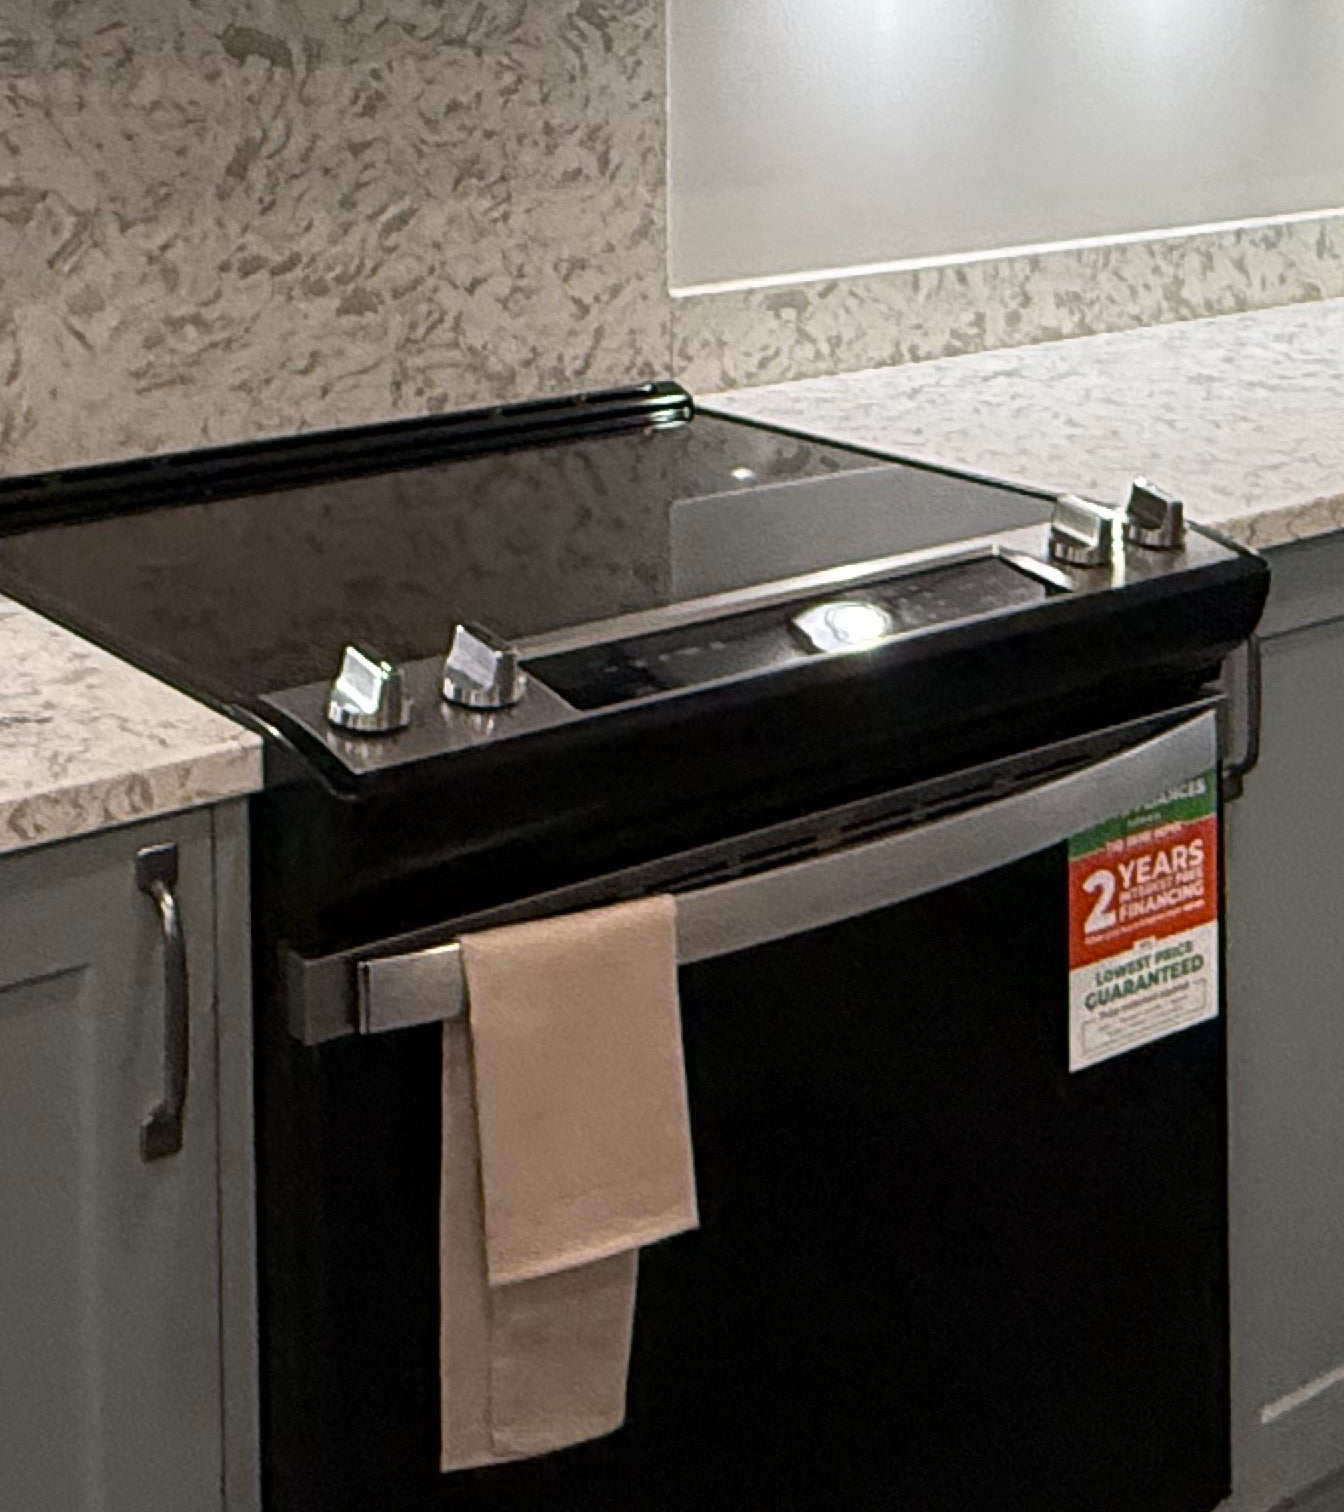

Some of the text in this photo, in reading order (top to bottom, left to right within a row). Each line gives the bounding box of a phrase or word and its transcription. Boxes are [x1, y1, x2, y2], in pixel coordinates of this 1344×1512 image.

[1082, 868, 1117, 934] 2
[1117, 838, 1204, 889] YEARS
[1084, 954, 1204, 1011] GUARANTEED
